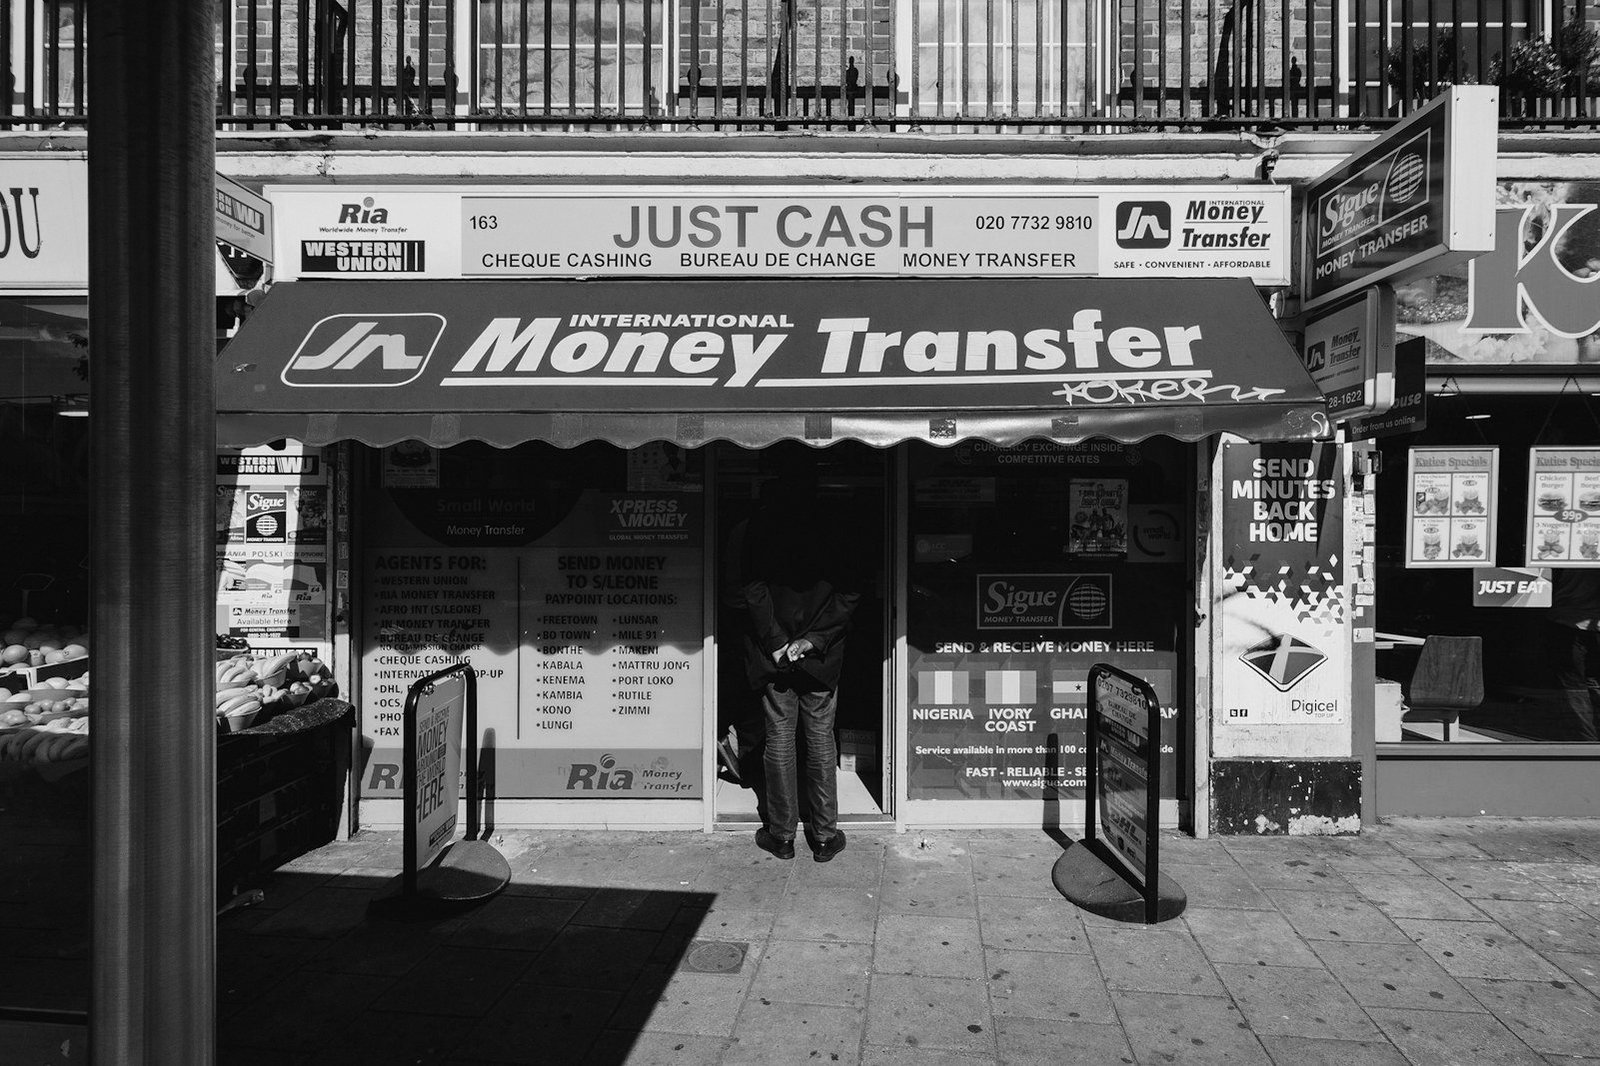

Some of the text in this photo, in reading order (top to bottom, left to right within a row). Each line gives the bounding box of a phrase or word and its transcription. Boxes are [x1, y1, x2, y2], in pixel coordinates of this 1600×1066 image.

[338, 197, 389, 224] Ria
[1186, 201, 1264, 223] Money
[1322, 182, 1381, 238] Sigue
[469, 215, 498, 230] 163
[613, 204, 933, 249] JUST CASH
[975, 216, 1093, 230] 020 7732 9810
[356, 227, 379, 235] Money
[1182, 226, 1271, 248] Transfer
[1322, 215, 1376, 249] MONEY TRANSFER
[305, 242, 402, 257] WESTERN
[1316, 215, 1429, 280] MONEY TRANSFER
[336, 257, 402, 272] UNION
[482, 253, 1076, 268] CHEQUE CASHING BUREAU DE CHANGE MONEY TRANSFER
[1114, 260, 1271, 269] SAFE CONVENIENT AFFORDABLE
[569, 314, 794, 328] INTERNATIONAL
[1331, 330, 1359, 349] Money
[451, 309, 1202, 387] Money Transfer
[1330, 346, 1361, 365] Transfer
[1352, 416, 1416, 434] Order from us online
[1091, 442, 1123, 452] INSIDE
[220, 457, 276, 465] WESTERN
[281, 456, 313, 473] WU
[998, 455, 1100, 464] COMPETITIVE RATES
[238, 465, 276, 473] UNION
[1252, 458, 1315, 478] SEND
[1231, 480, 1336, 499] MINUTES
[247, 493, 285, 511] Sigue
[437, 499, 481, 512] Small
[610, 500, 679, 513] XPRESS
[1253, 501, 1316, 521] BACK
[1561, 511, 1583, 523] 99p
[628, 513, 688, 527] MONEY
[447, 524, 525, 538] Money Transfer
[1250, 522, 1318, 542] HOME
[252, 550, 283, 558] POLSKI
[375, 555, 487, 570] AGENTS FOR:
[558, 556, 667, 570] SEND MONEY
[381, 576, 468, 585] WESTERN UNION
[566, 575, 659, 590] TO S/LEONE
[1478, 580, 1548, 595] JUST EAT
[295, 592, 313, 601] Ria
[380, 590, 495, 600] RIA MONEY TRANSFER
[545, 594, 678, 605] PAYPOINT LOCATIONS:
[984, 580, 1057, 614] Sigue
[380, 604, 481, 615] AFRO INT (S/LEONE)
[400, 619, 490, 628] MONEY TRANSFER
[543, 615, 598, 625] FREETOWN
[618, 615, 658, 625] LUNSAR
[380, 633, 421, 643] BUREAU
[425, 633, 439, 643] DE
[543, 630, 591, 639] BO TOWN
[618, 630, 657, 639] MILE 91
[380, 643, 481, 651] NO COMMISSION CHARGE
[543, 645, 583, 654] BONTHE
[618, 645, 659, 654] MAKENI
[935, 641, 1155, 653] SEND & RECEIVE MONEY HERE
[380, 656, 471, 665] CHEQUE CASHING
[542, 661, 583, 670] KABALA
[618, 661, 690, 670] MATTRU JONG
[542, 676, 586, 685] KENEMA
[618, 676, 674, 685] PORT LOKO
[380, 685, 404, 694] DHL,
[542, 691, 583, 700] KAMBIA
[618, 691, 652, 700] RUTILE
[380, 699, 403, 709] OCS,
[1291, 699, 1338, 715] Digicel
[542, 706, 572, 715] KONO
[618, 706, 651, 715] ZIMMI
[912, 708, 974, 720] NIGERIA
[989, 708, 1034, 720] IVORY
[380, 727, 400, 736] FAX
[542, 721, 573, 730] LUNGI
[984, 721, 1037, 732] COAST
[417, 720, 449, 759] MONEY
[915, 746, 951, 755] Service
[953, 746, 994, 755] available
[996, 746, 1005, 754] in
[1035, 746, 1056, 754] than
[1060, 746, 1076, 754] 100
[566, 754, 633, 791] Ria
[642, 769, 684, 780] Money
[966, 767, 997, 777] FAST
[1007, 767, 1065, 777] RELIABLE
[1003, 778, 1087, 788] www.sigue.com
[416, 771, 445, 824] HERE
